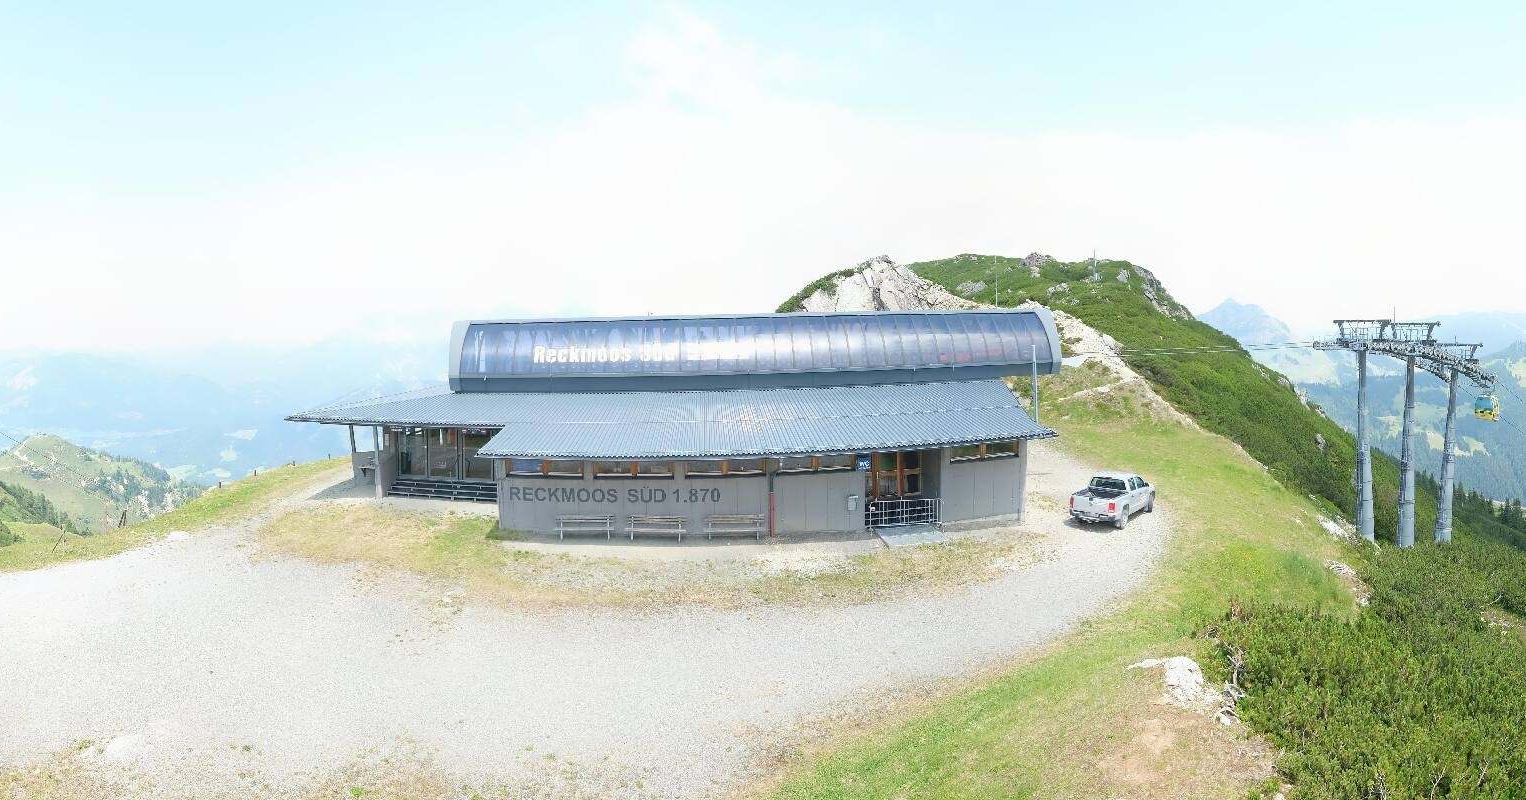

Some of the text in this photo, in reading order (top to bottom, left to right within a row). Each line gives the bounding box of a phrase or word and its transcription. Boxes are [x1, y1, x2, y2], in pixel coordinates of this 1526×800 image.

[509, 486, 721, 503] RECKMOOS SÜD 1.870
